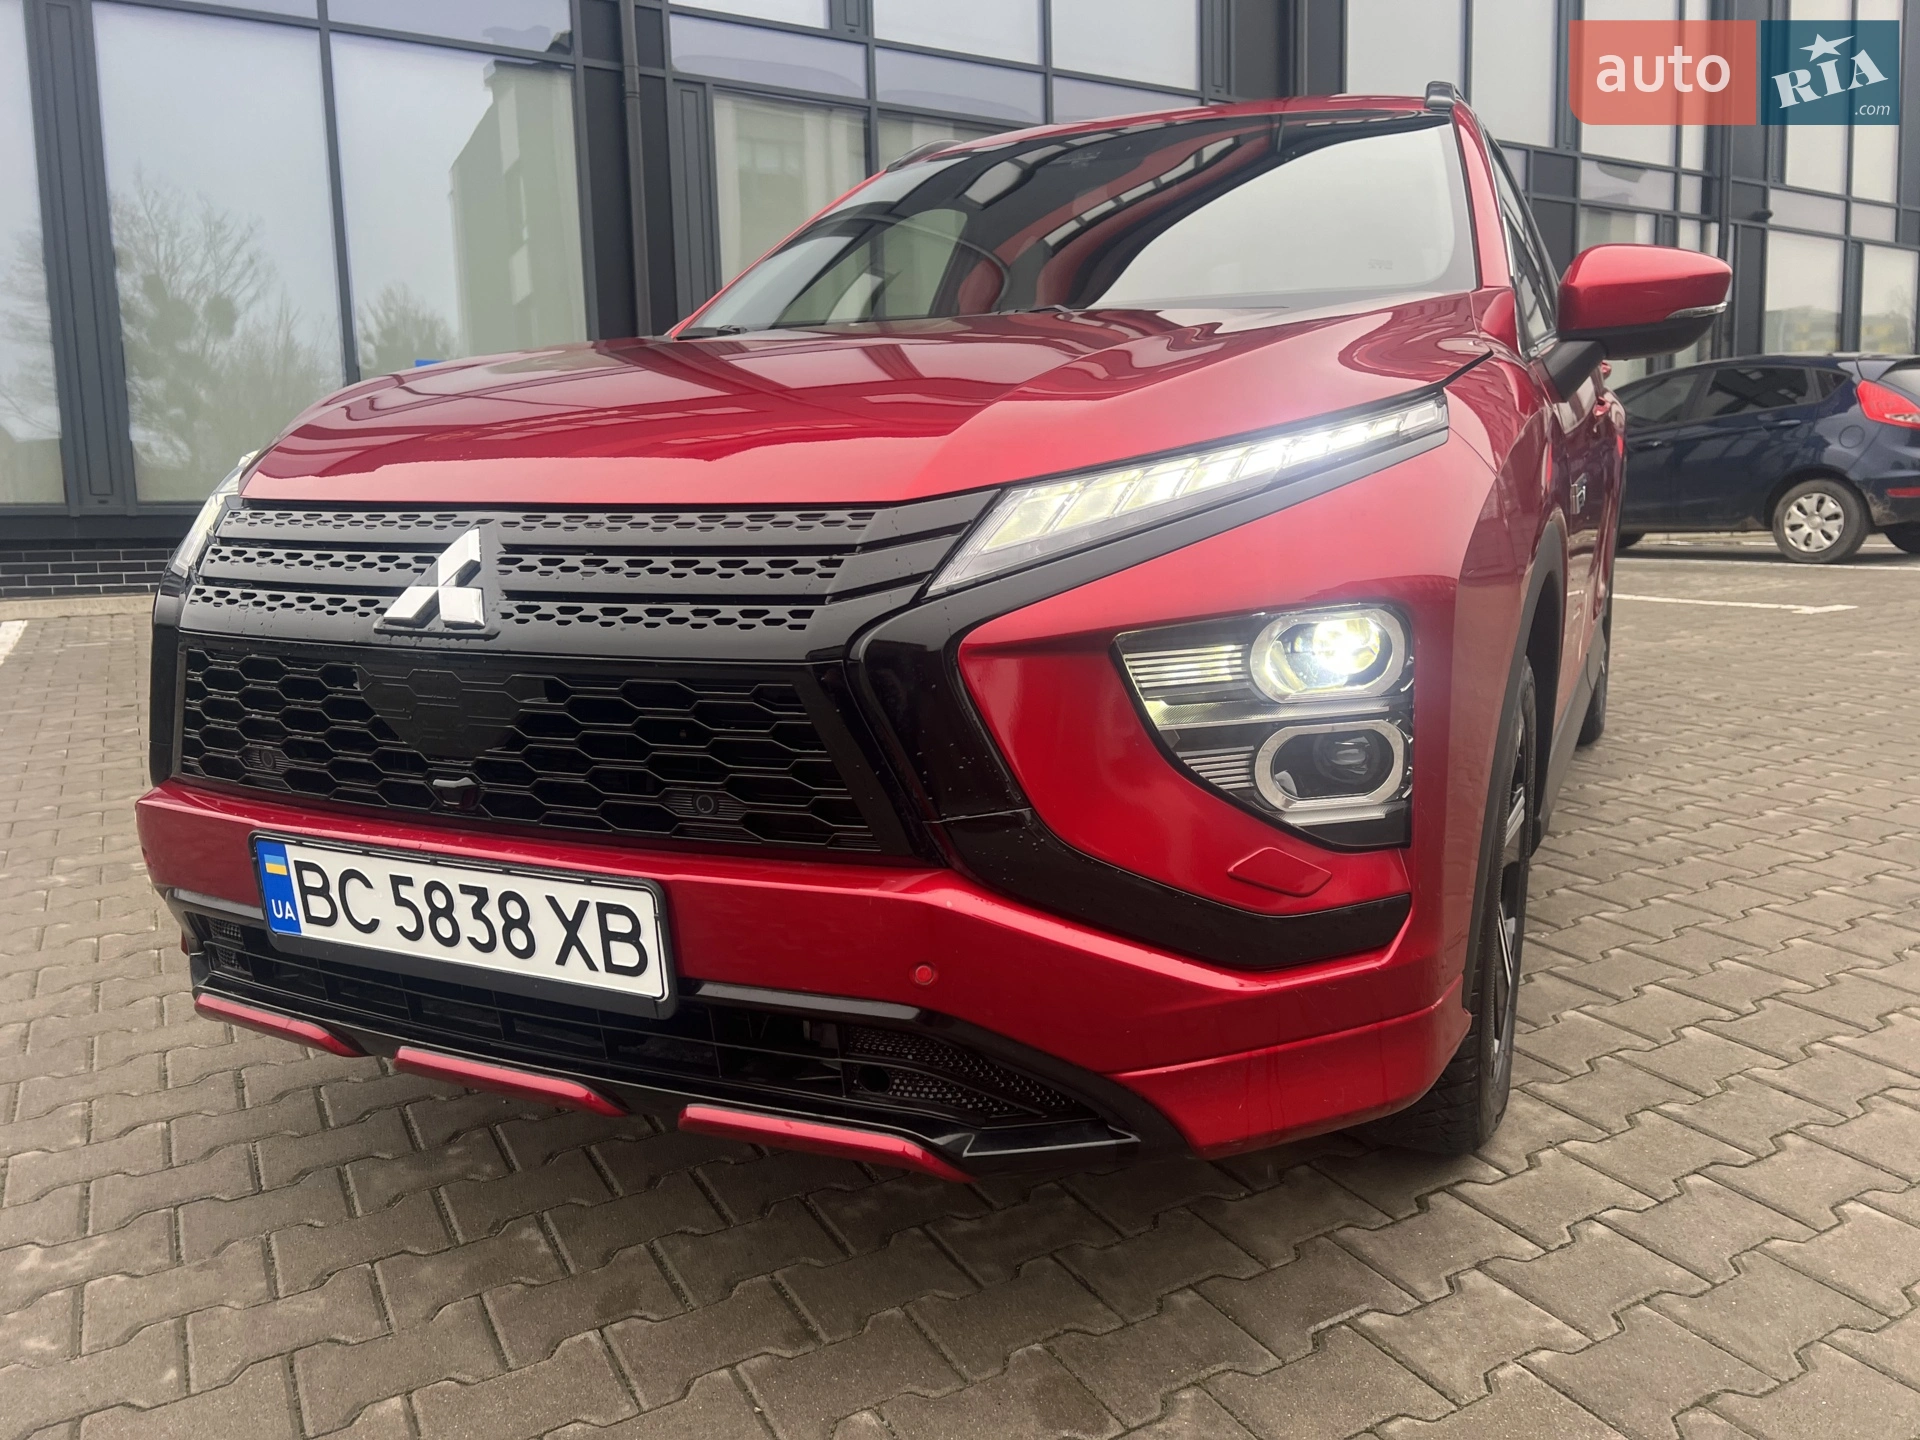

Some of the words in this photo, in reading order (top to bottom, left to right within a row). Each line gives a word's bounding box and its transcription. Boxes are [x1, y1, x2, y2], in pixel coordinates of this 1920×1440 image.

[272, 899, 296, 921] UA
[294, 860, 380, 934] BC
[390, 874, 536, 959] 5838
[545, 895, 648, 977] XB
